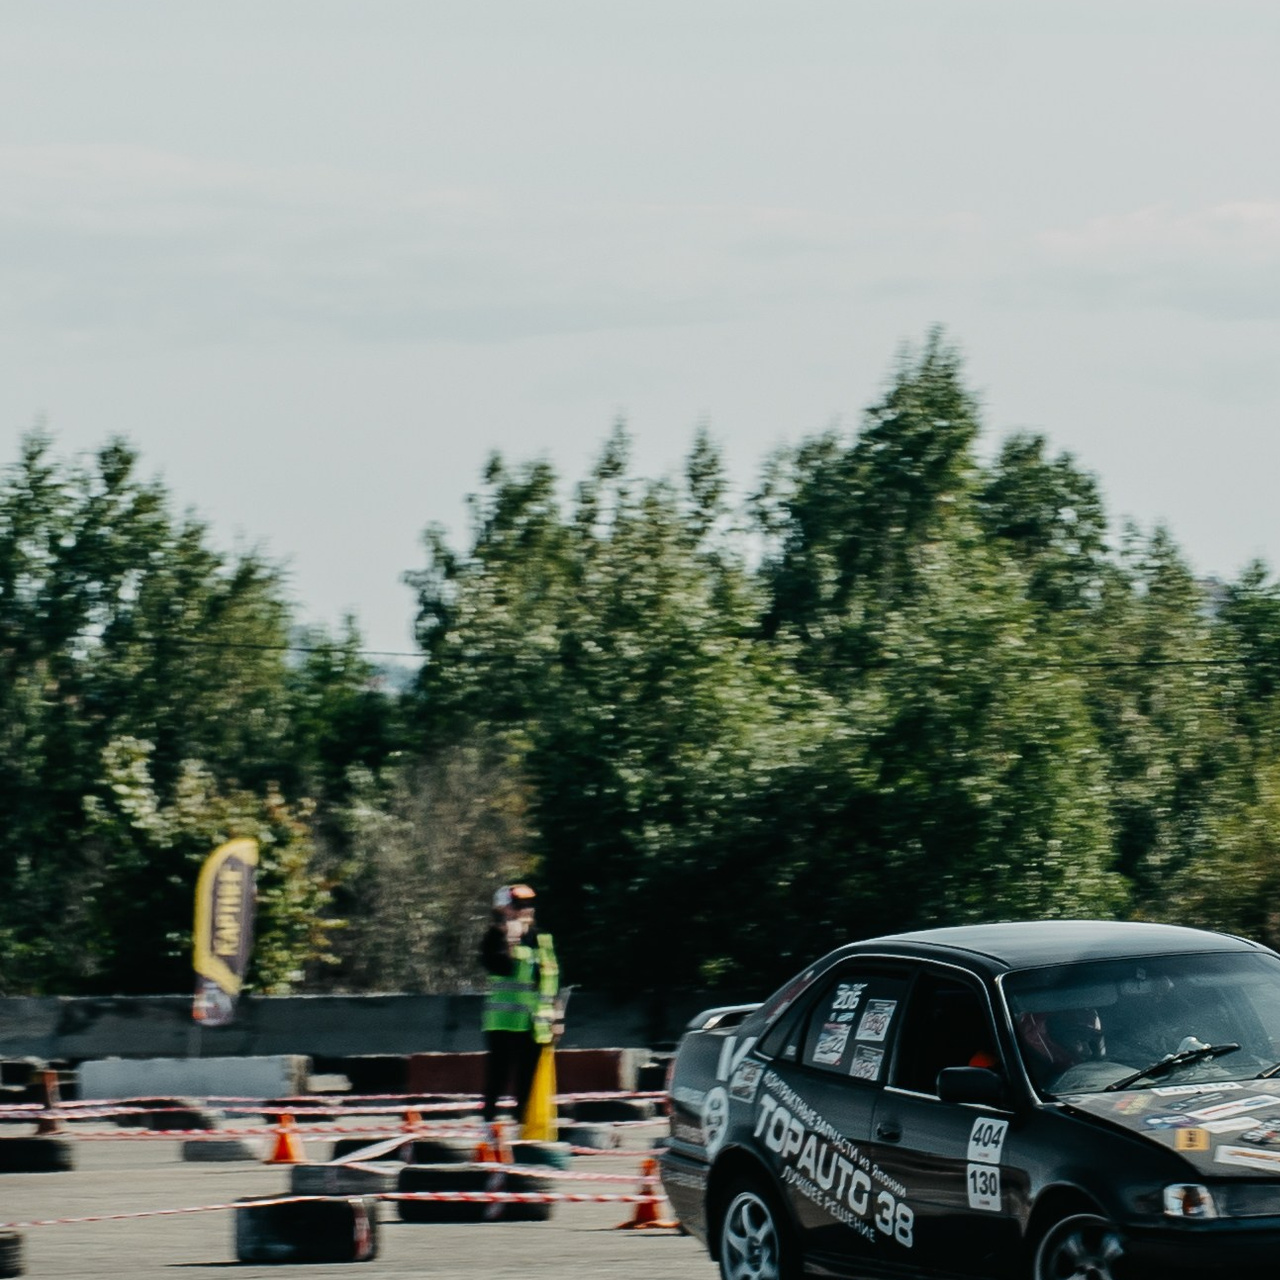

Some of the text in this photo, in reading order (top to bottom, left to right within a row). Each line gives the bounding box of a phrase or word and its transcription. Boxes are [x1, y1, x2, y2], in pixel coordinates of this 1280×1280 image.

[972, 1123, 1005, 1148] 404
[754, 1093, 872, 1216] TOPAUTO
[875, 1190, 914, 1248] 38
[970, 1169, 997, 1196] 130
